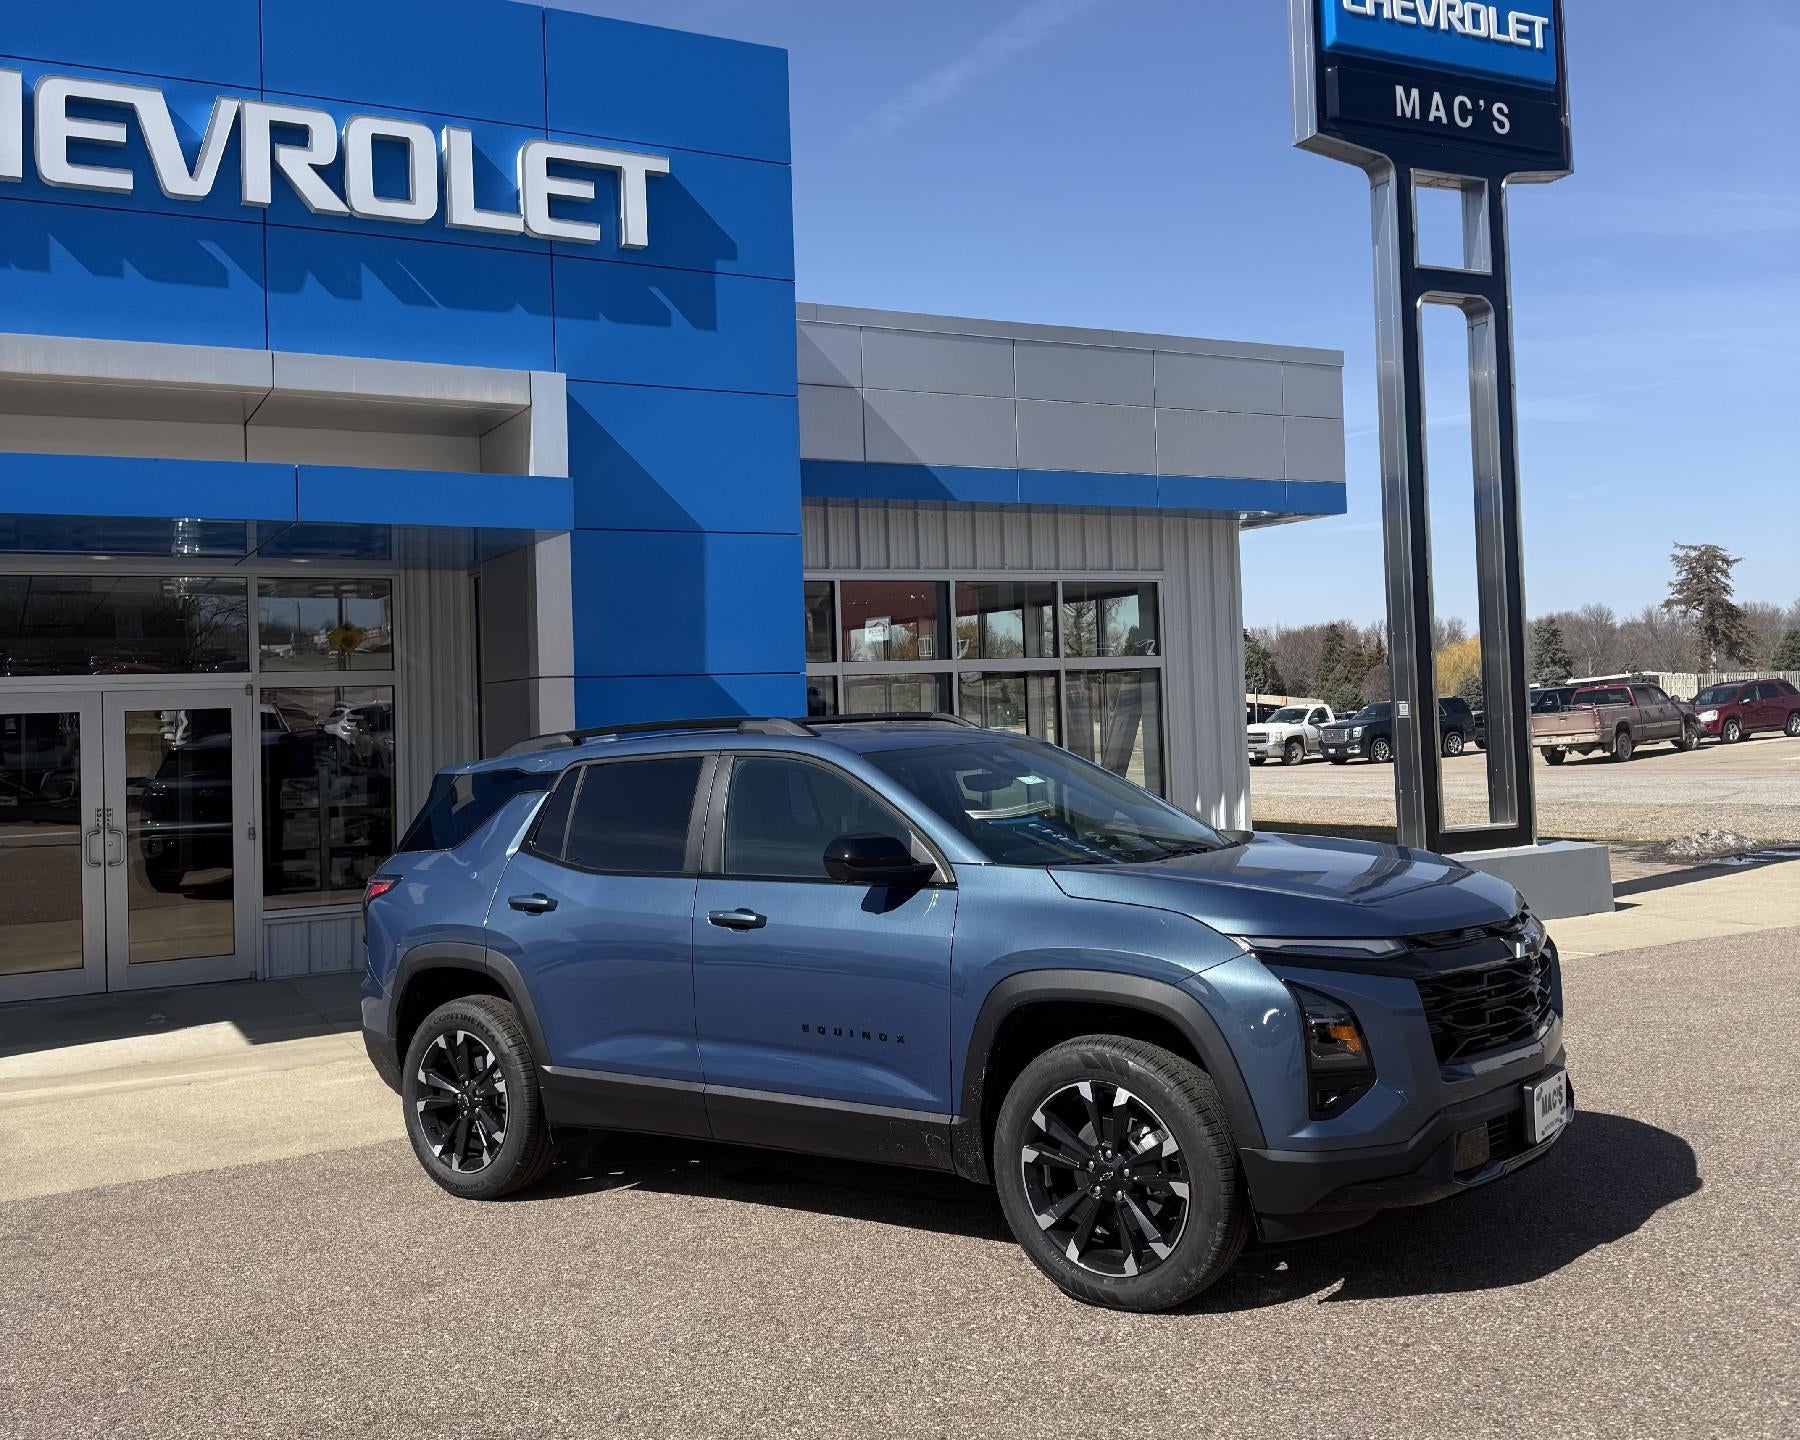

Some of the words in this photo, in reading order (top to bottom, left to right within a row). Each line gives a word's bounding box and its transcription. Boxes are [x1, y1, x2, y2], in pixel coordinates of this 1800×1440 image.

[1394, 84, 1511, 135] MAC'S
[0, 67, 670, 250] EVROLET
[433, 1012, 500, 1047] CONTINENTAL
[801, 1023, 905, 1044] EQUINOX
[1541, 1084, 1564, 1118] MAC'S
